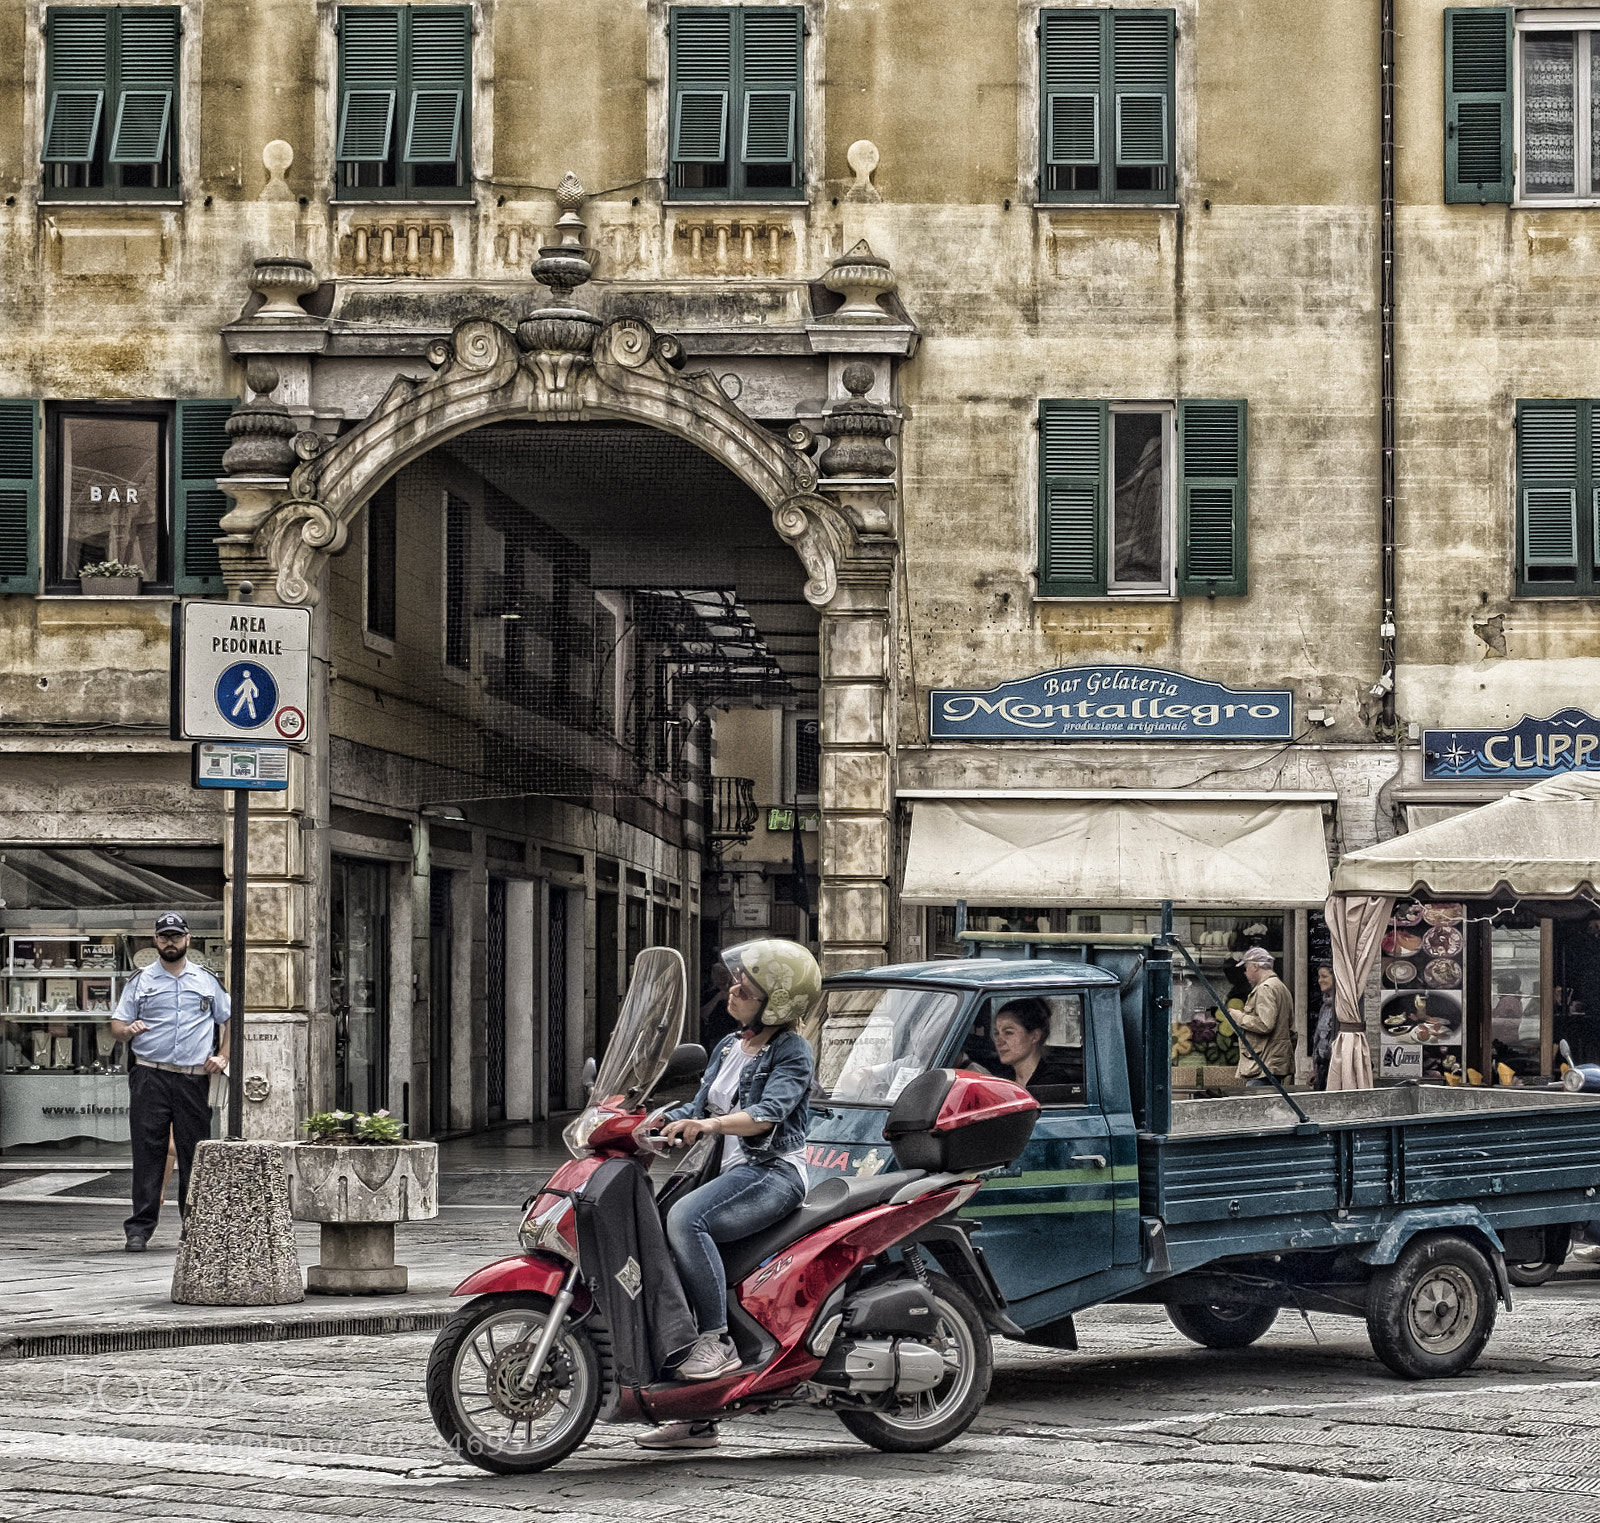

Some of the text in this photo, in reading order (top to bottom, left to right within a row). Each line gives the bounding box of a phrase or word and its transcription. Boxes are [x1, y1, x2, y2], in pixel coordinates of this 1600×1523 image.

[90, 486, 139, 504] BAR
[229, 615, 267, 633] AREA
[212, 636, 283, 656] PEDONALE
[1043, 670, 1180, 697] Bar Gelateria
[942, 696, 1281, 729] Montallegro
[1061, 720, 1189, 734] produzione artigianale
[1484, 733, 1600, 768] CLIPP
